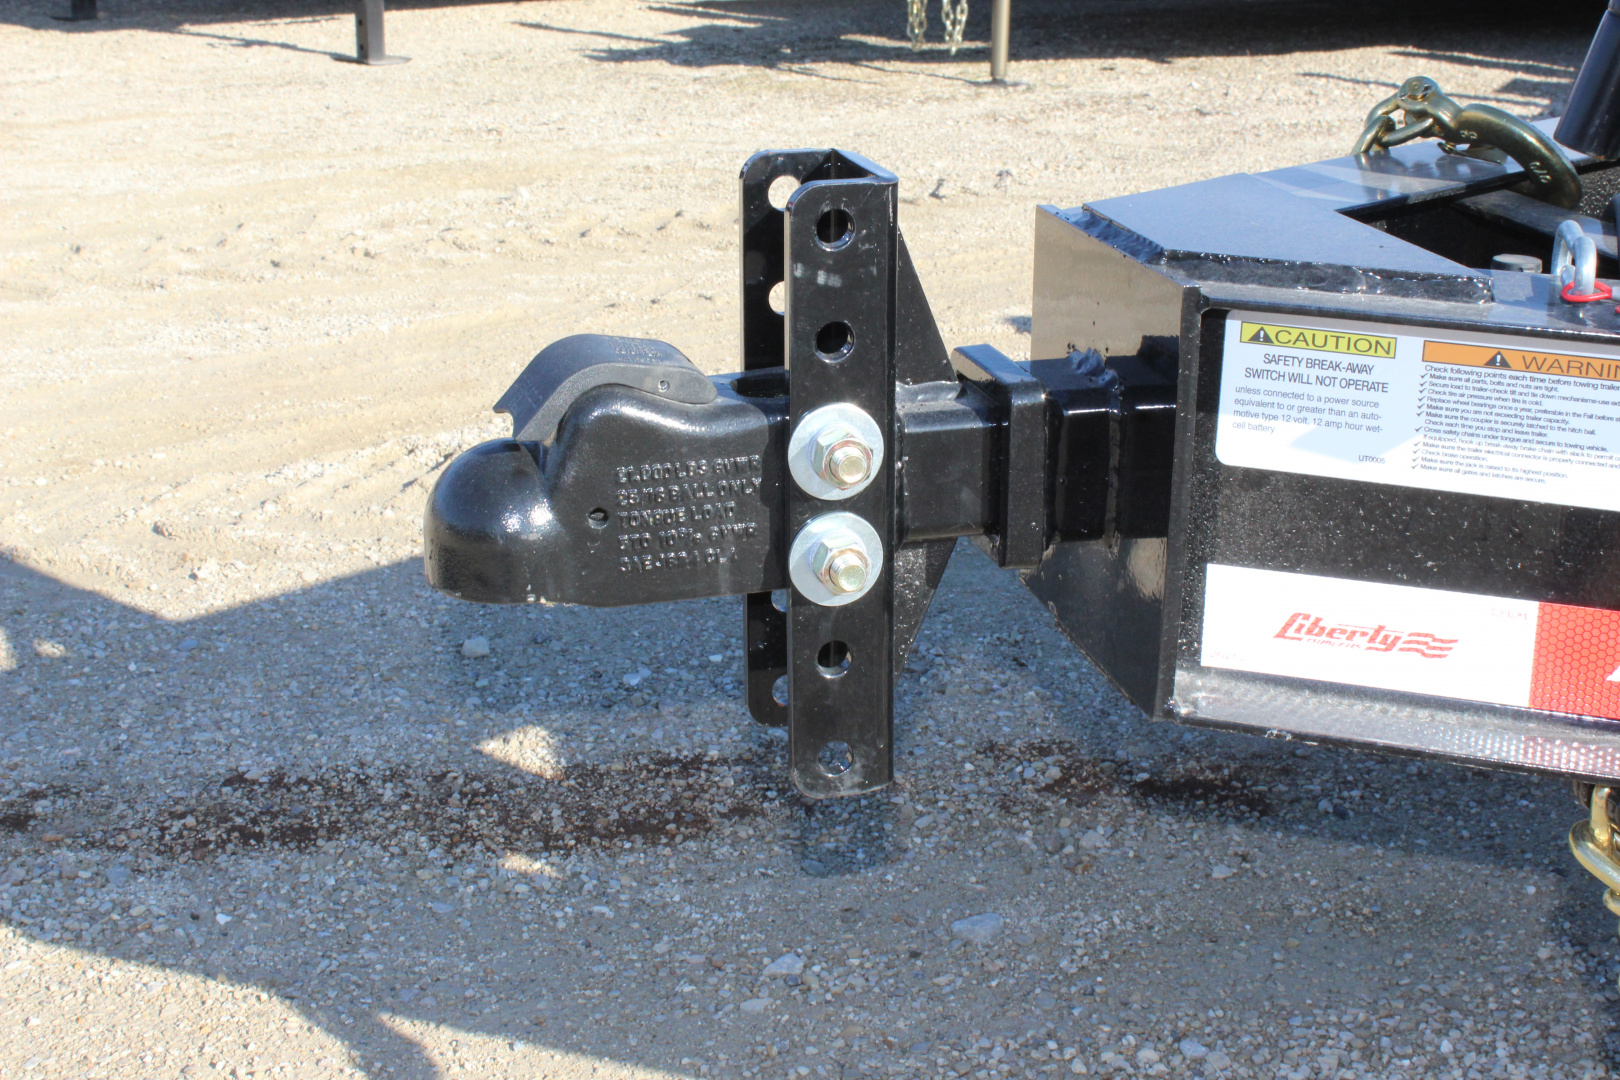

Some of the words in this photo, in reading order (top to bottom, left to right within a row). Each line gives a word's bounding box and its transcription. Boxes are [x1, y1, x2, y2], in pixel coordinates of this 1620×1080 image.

[1275, 329, 1391, 355] CAUTION
[1263, 353, 1303, 368] SAFETY
[1306, 358, 1374, 375] BREAK-AWAY
[1245, 368, 1285, 382] SWITCH
[1288, 372, 1313, 385] WILL
[1316, 375, 1338, 387] NOT
[1339, 378, 1388, 393] OPERATE
[1425, 365, 1448, 373] Check
[1450, 367, 1482, 378] following
[1484, 371, 1506, 380] points
[1508, 374, 1527, 382] each
[1548, 378, 1572, 386] before
[1573, 381, 1598, 390] towing
[1235, 385, 1261, 395] unless
[1263, 388, 1304, 400] connected
[1306, 393, 1314, 401] to
[1324, 396, 1349, 406] power
[1352, 399, 1379, 408] source
[1234, 398, 1274, 410] equivalent
[1277, 402, 1284, 410] to
[1297, 404, 1325, 416] greater
[1328, 408, 1346, 416] than
[1361, 411, 1382, 420] auto-
[1234, 409, 1260, 419] motive
[1261, 412, 1278, 423] type
[1282, 414, 1291, 423] 12
[1313, 418, 1322, 426] 12
[1324, 420, 1342, 430] amp
[1345, 421, 1363, 430] hour
[1365, 423, 1383, 432] wet-
[1470, 416, 1493, 425] coupler
[1248, 423, 1275, 434] battery
[1500, 435, 1521, 443] tongue
[1564, 442, 1585, 450] towing
[1272, 612, 1402, 652] Liberty
